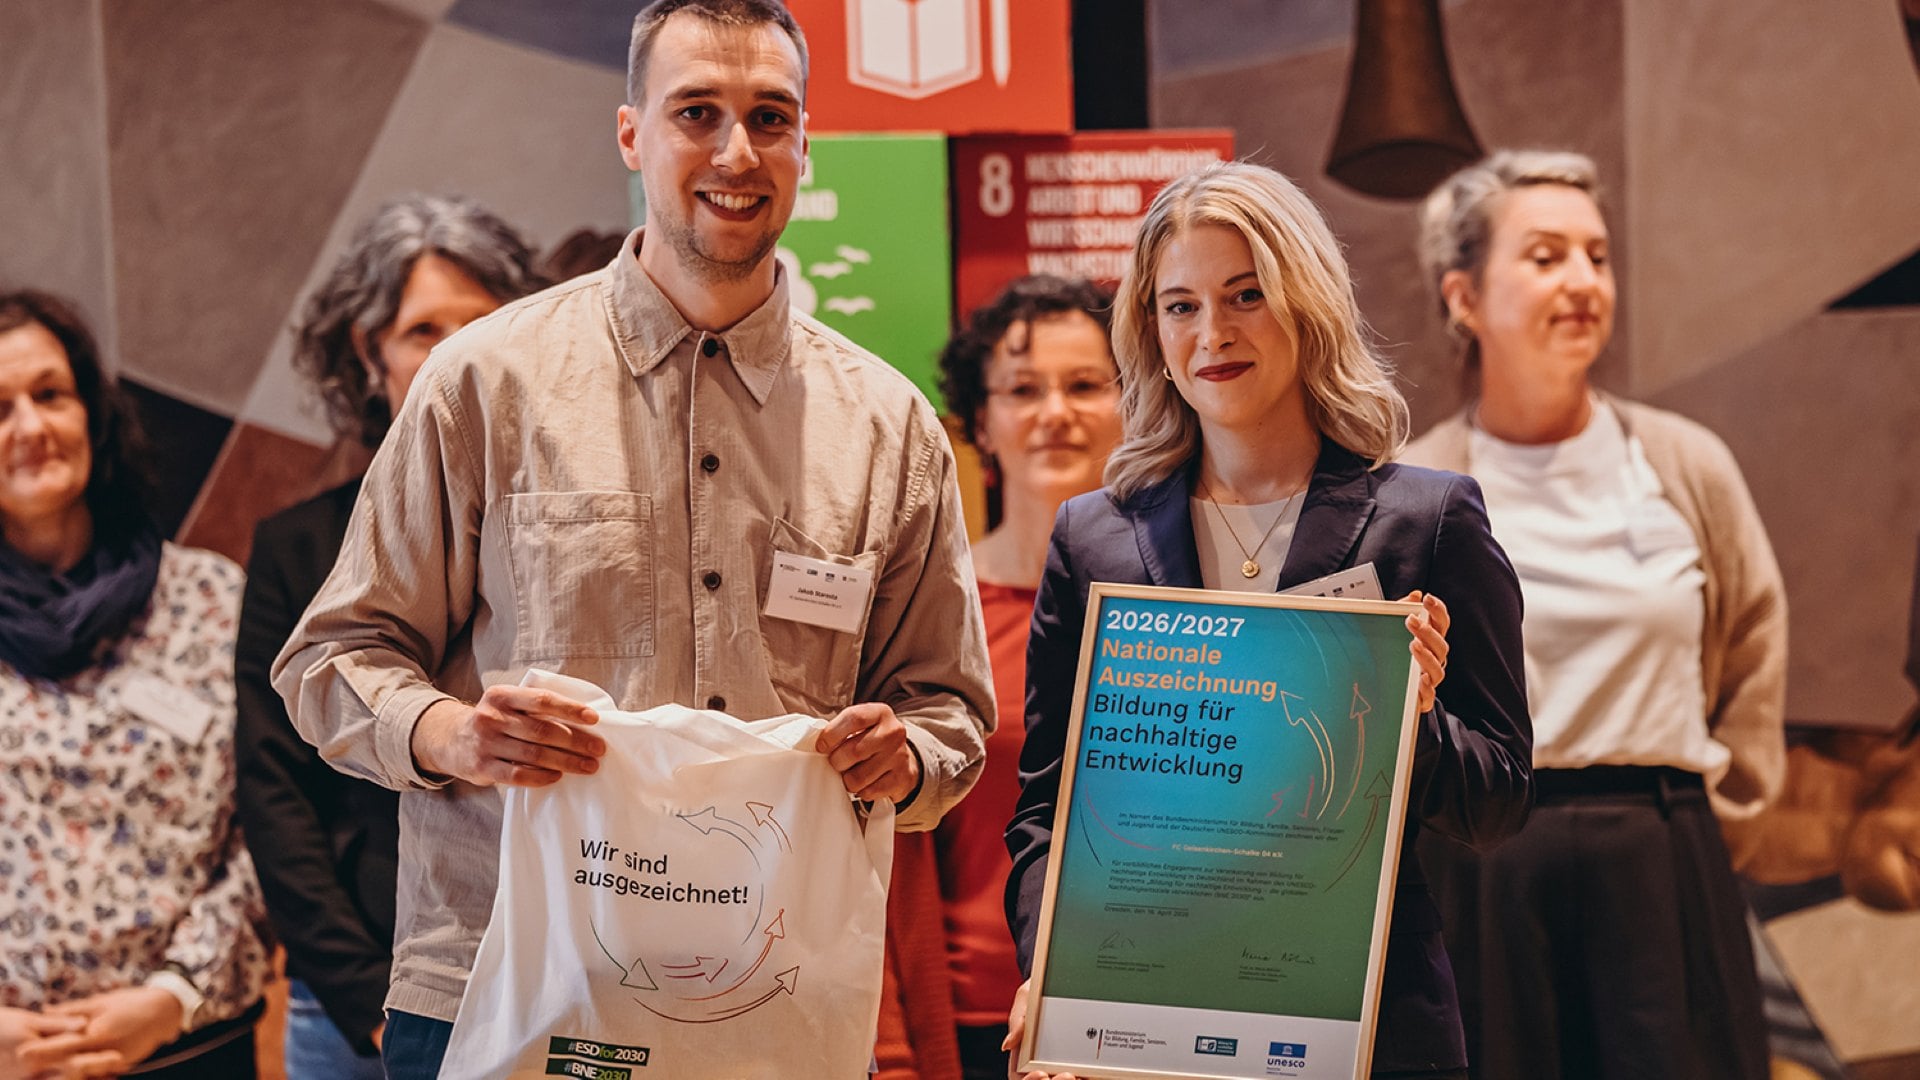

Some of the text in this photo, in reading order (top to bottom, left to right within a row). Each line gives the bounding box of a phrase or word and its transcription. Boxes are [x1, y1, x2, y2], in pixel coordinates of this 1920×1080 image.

[979, 153, 1014, 217] 8
[1028, 183, 1142, 215] ARBEIT UND
[1106, 609, 1245, 638] 2026/2027
[1101, 638, 1223, 665] Nationale
[1098, 666, 1277, 702] Auszeichnung
[1093, 694, 1236, 724] Bildung für
[1089, 723, 1237, 754] nachhaltige
[1085, 750, 1244, 784] Entwicklung
[580, 838, 668, 875] Wir sind
[574, 868, 748, 904] ausgezeichnet!
[567, 1041, 646, 1062] #ESDfor2030
[1267, 1058, 1305, 1068] unesco
[563, 1061, 628, 1080] #BNE2030
